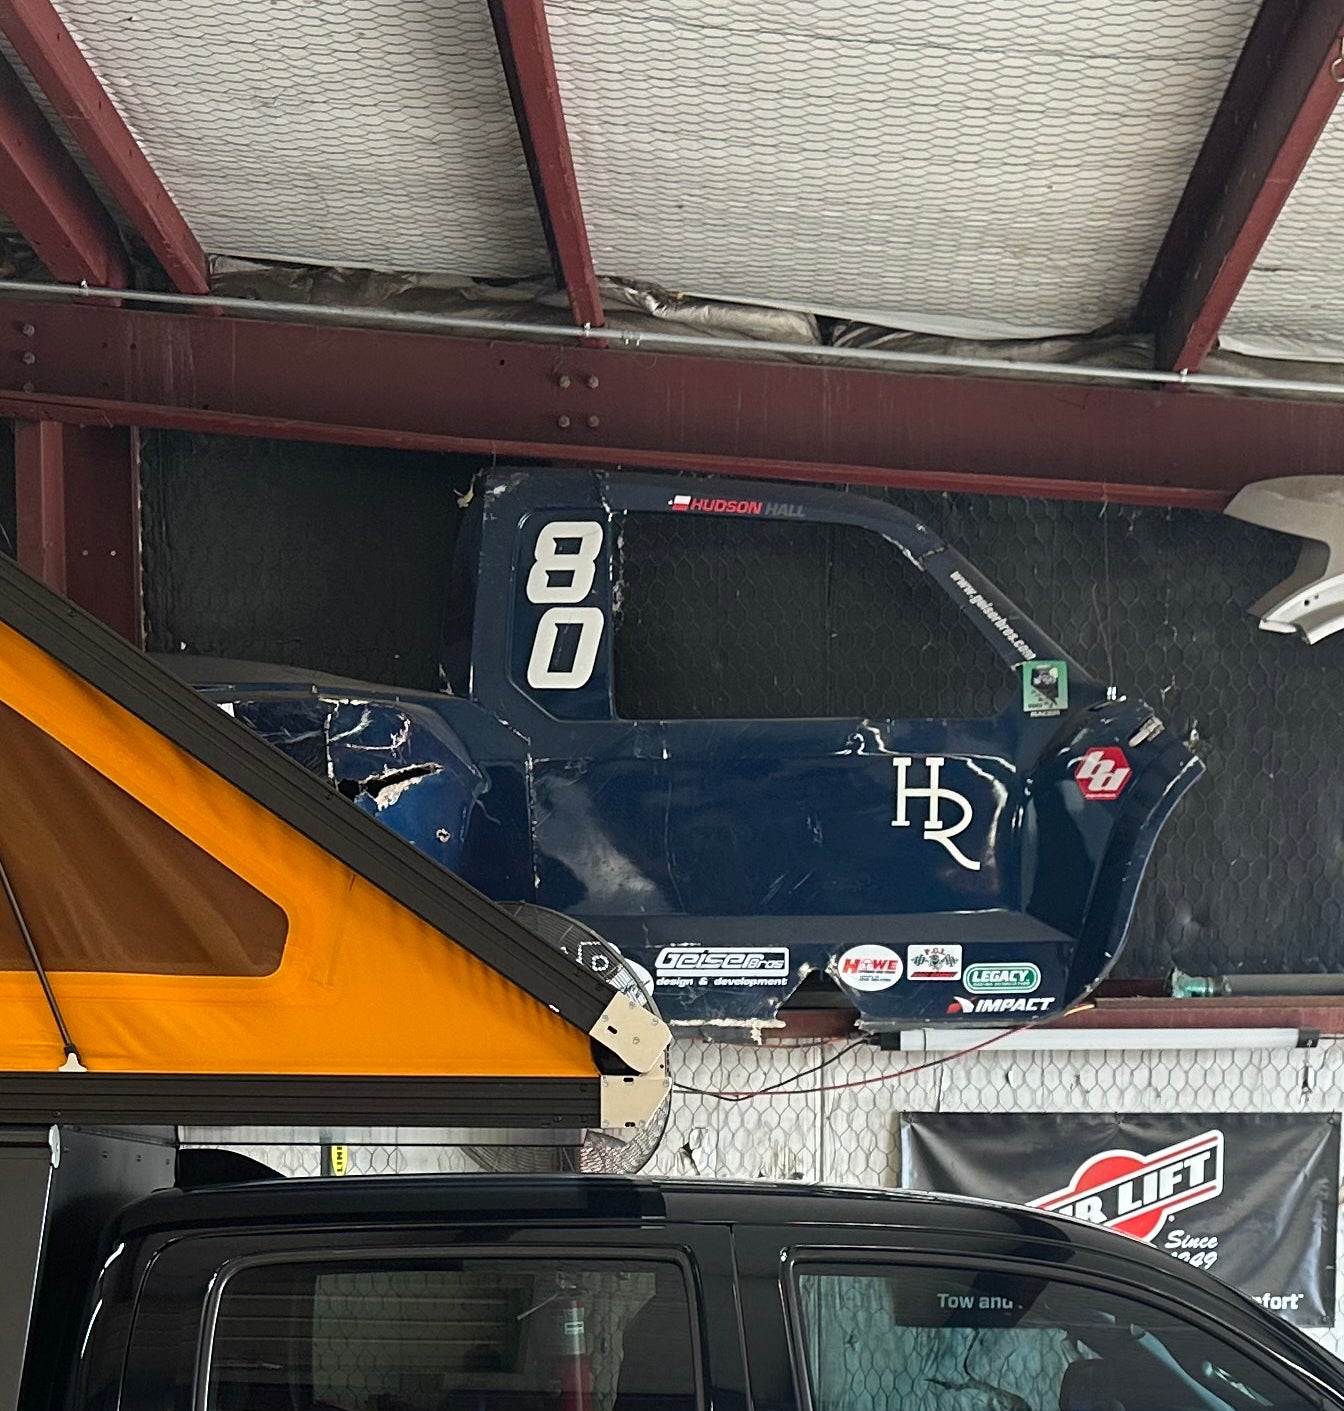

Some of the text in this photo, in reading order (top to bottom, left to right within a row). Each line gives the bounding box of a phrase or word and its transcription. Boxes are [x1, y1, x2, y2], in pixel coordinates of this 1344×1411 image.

[690, 498, 805, 518] HUDSON HALL
[950, 571, 1036, 660] www.geiserbros.com
[747, 958, 785, 969] Bros
[656, 977, 788, 987] design & development
[972, 970, 1029, 982] LEGACY
[975, 997, 1055, 1013] IMPACT
[1118, 1151, 1211, 1215] LIFT
[1164, 1229, 1218, 1249] Since
[937, 1293, 974, 1309] Tow
